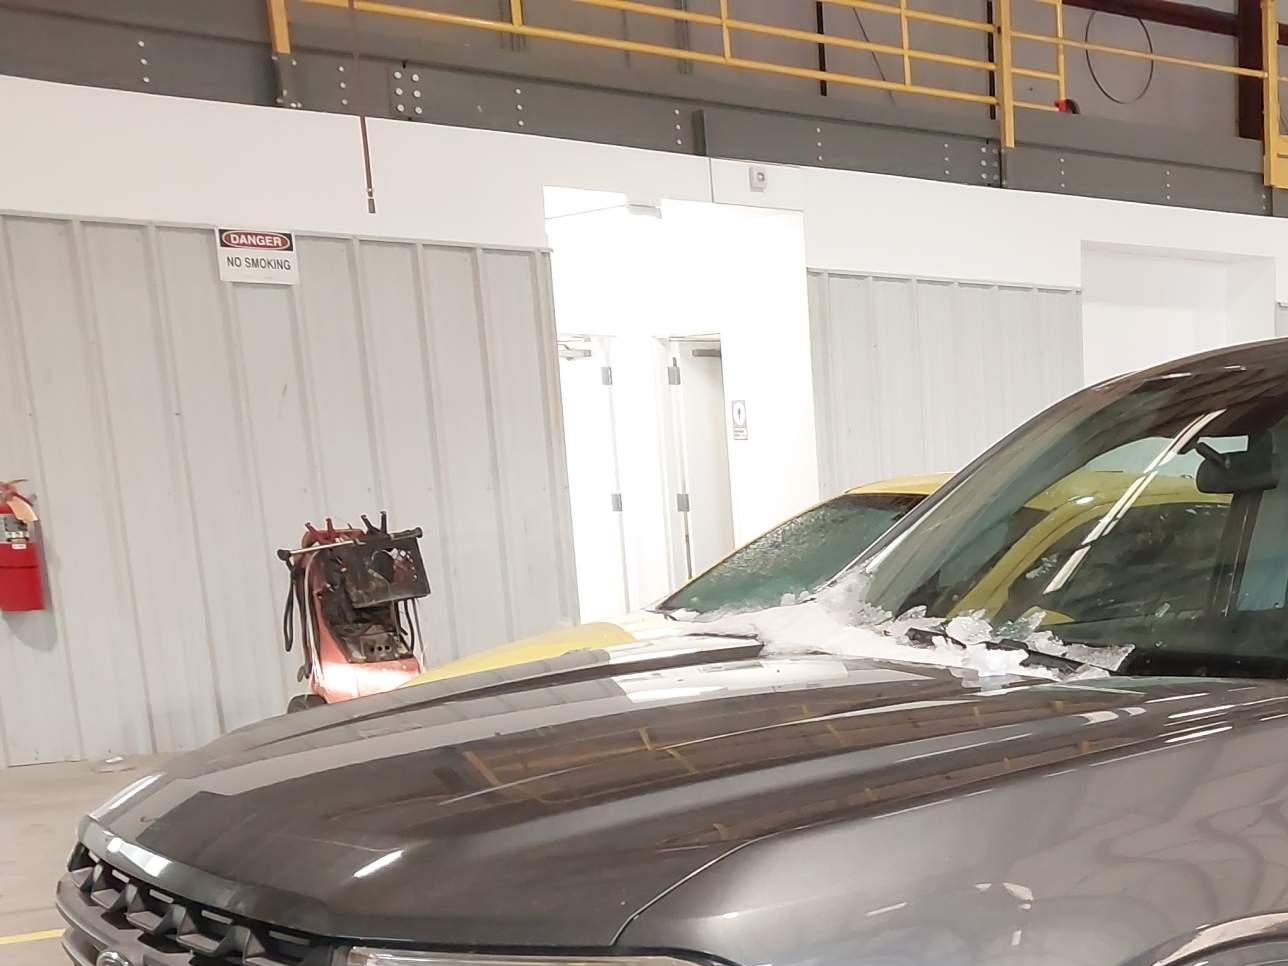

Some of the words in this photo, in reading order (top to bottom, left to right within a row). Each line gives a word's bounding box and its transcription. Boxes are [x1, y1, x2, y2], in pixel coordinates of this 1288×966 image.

[230, 234, 282, 247] DANGER
[227, 256, 242, 268] NO
[244, 256, 291, 270] SMOKING
